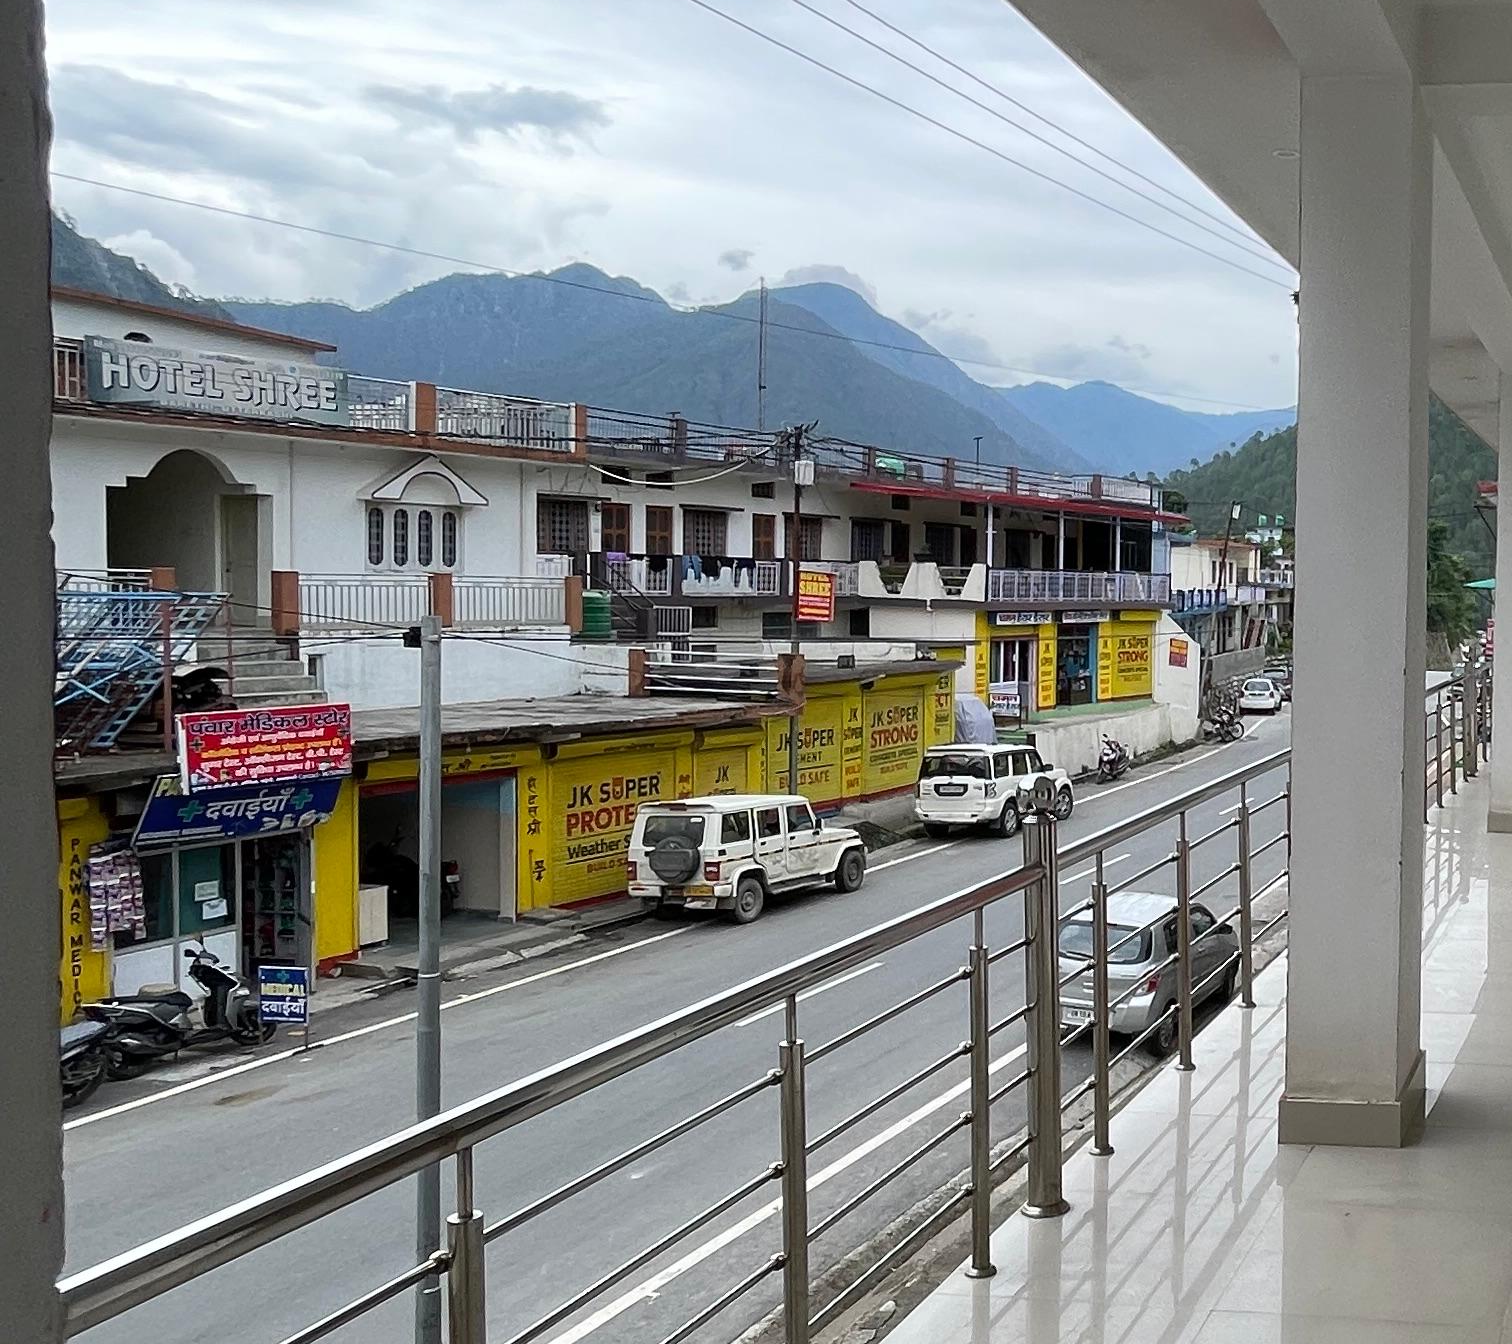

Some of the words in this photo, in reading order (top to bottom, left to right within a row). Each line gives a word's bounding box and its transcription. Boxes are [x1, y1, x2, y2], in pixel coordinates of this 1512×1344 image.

[102, 352, 224, 399] HOTEL
[233, 367, 338, 411] SHREE
[1118, 650, 1148, 664] STRONG
[240, 712, 309, 732] मेडिकल
[313, 707, 349, 726] स्टोर
[871, 711, 884, 728] JK
[887, 705, 918, 725] SUPER
[797, 727, 834, 749] SUPER
[870, 724, 918, 748] STRONG
[715, 765, 729, 783] JK
[205, 787, 295, 820] दवाईयाँ
[567, 784, 593, 808] JK
[600, 775, 660, 803] SUPER
[567, 803, 635, 836] PROTE
[567, 838, 621, 860] Weather
[70, 838, 83, 924] PANWAR
[70, 935, 86, 1017] MEDICA
